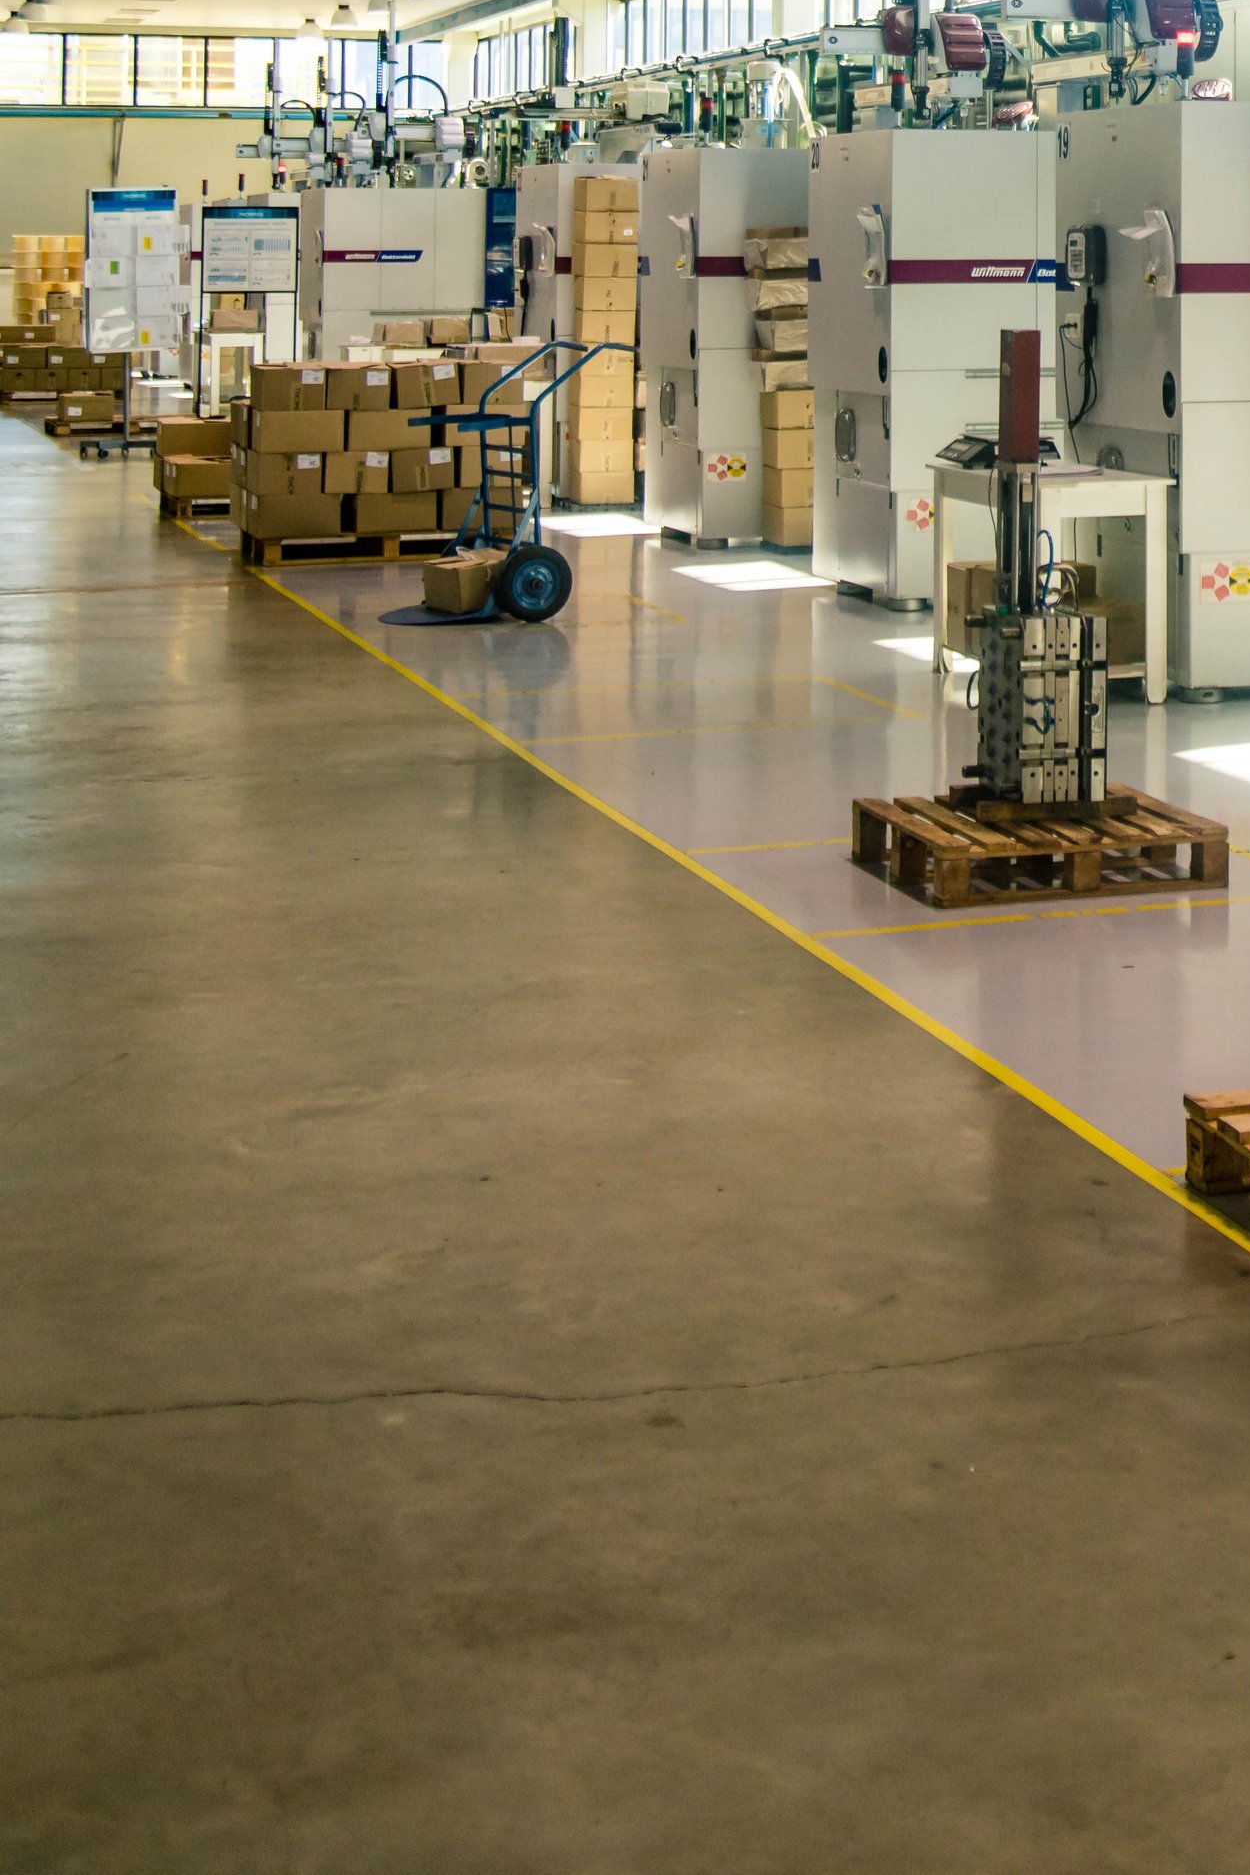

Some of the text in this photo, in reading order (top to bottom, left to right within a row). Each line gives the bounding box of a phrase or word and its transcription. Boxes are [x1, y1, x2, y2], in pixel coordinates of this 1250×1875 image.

[811, 141, 820, 169] 20
[1058, 125, 1069, 159] 19
[970, 266, 1026, 278] Wittmann
